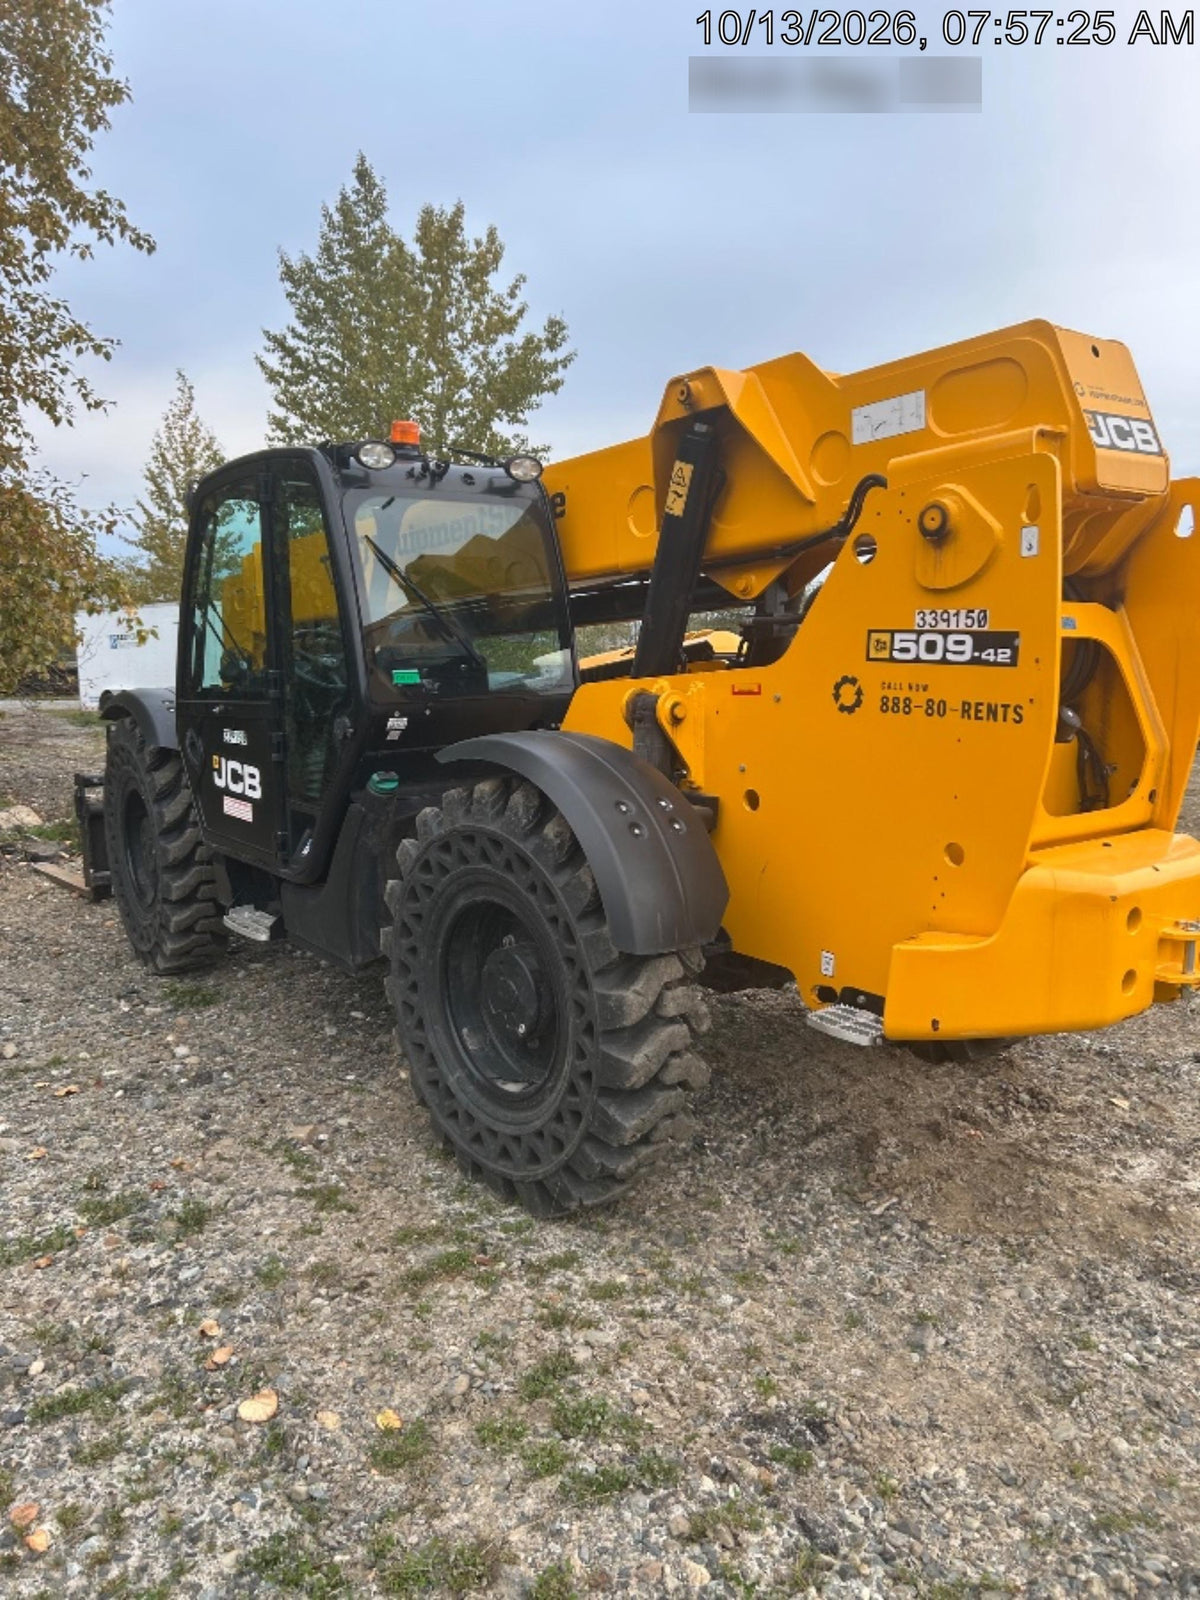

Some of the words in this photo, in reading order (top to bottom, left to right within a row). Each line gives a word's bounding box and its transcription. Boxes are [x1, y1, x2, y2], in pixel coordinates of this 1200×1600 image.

[1089, 413, 1160, 453] JCB
[916, 609, 988, 629] 339150
[892, 632, 1012, 663] 509-42
[879, 695, 1024, 724] 888-80-RENTS
[213, 756, 262, 799] JCB
